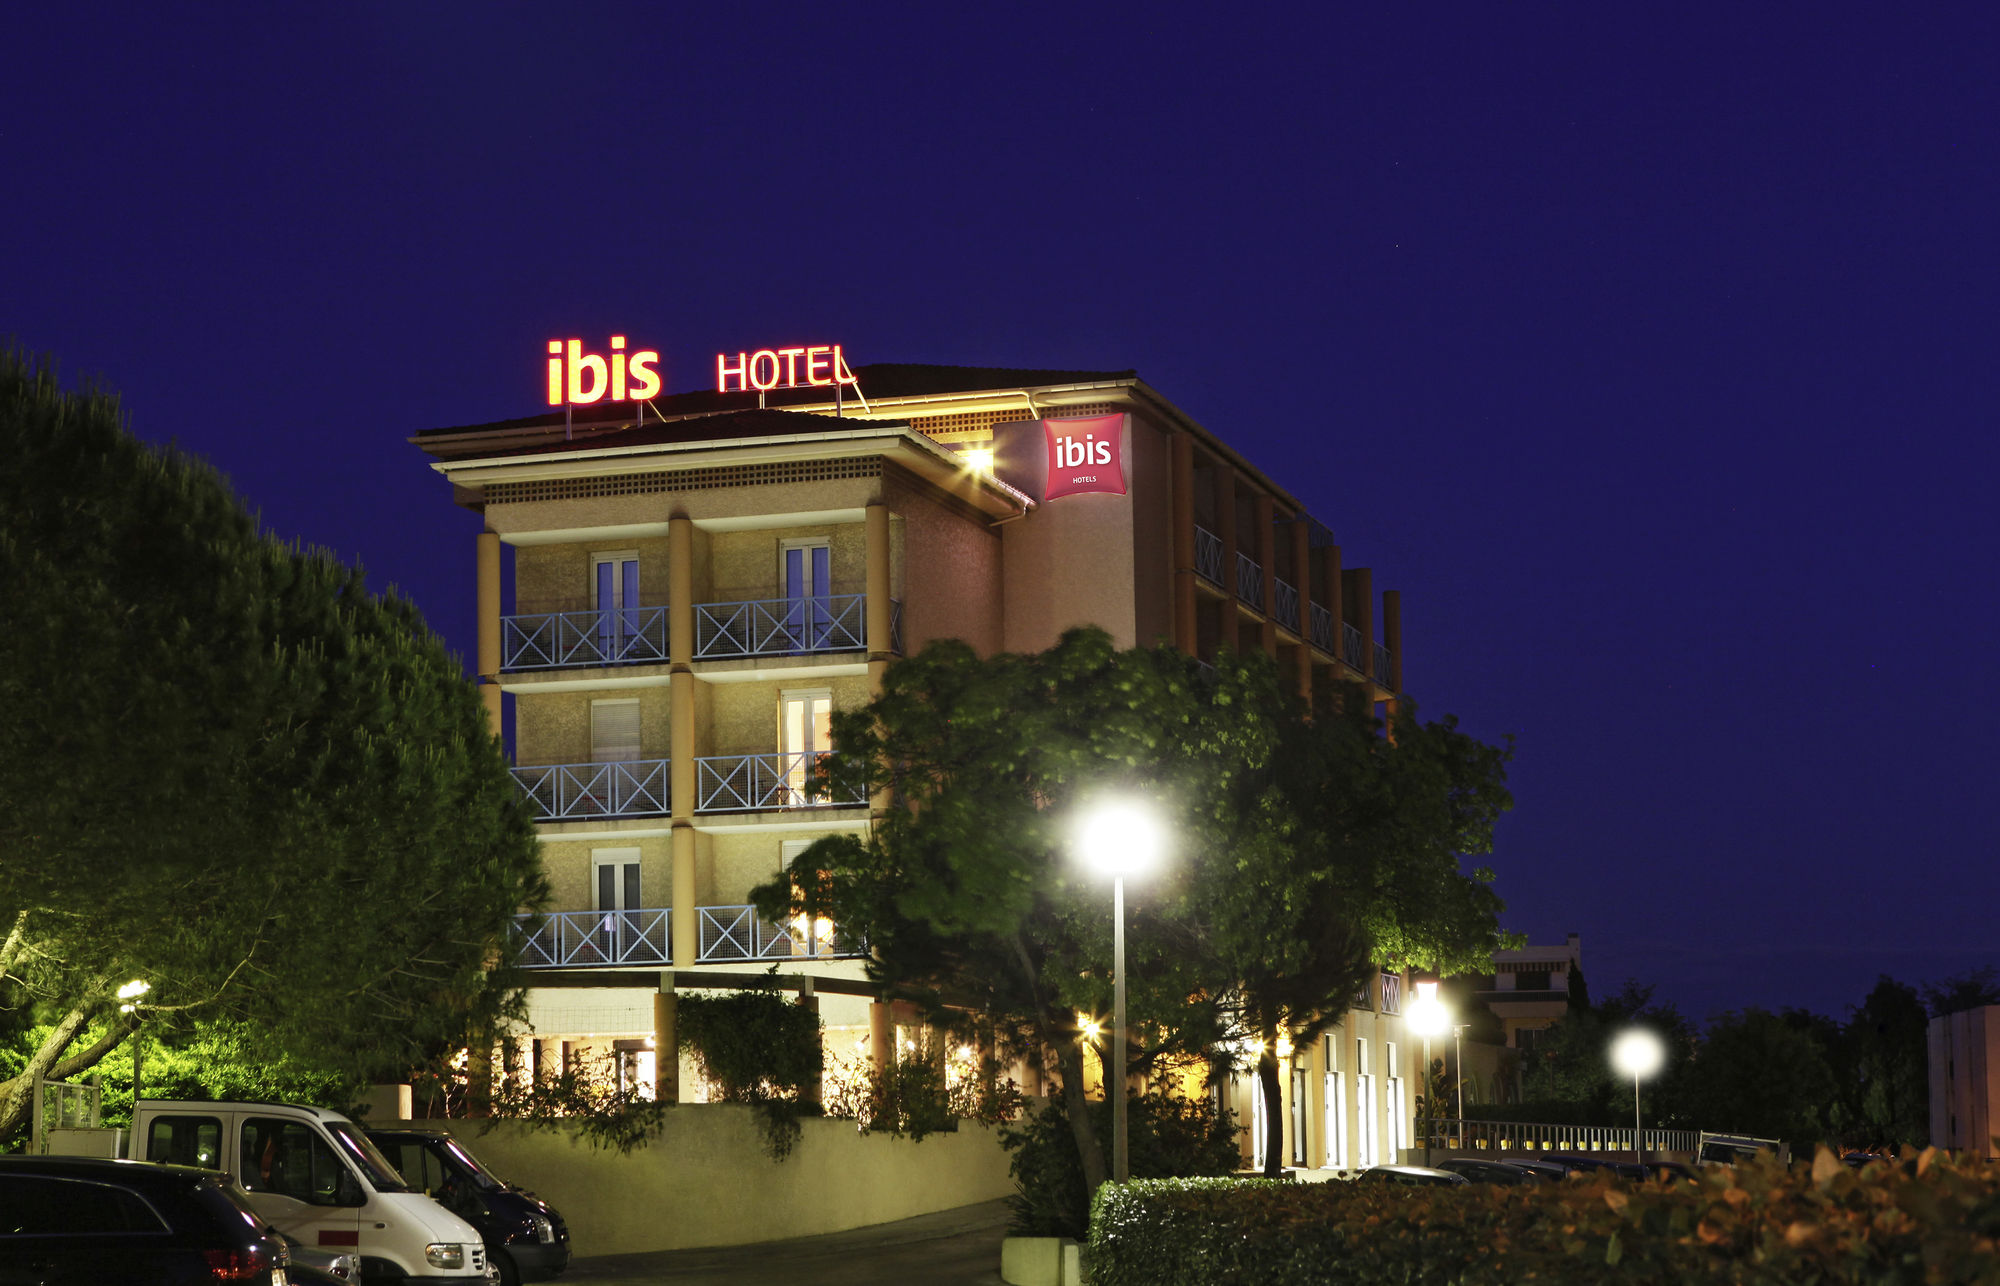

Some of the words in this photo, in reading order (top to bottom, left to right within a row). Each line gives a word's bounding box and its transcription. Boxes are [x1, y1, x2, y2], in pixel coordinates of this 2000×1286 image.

[548, 336, 662, 405] ibis
[717, 345, 857, 393] HOTEL
[1056, 434, 1111, 468] ibis
[1072, 475, 1097, 484] HOTELS
